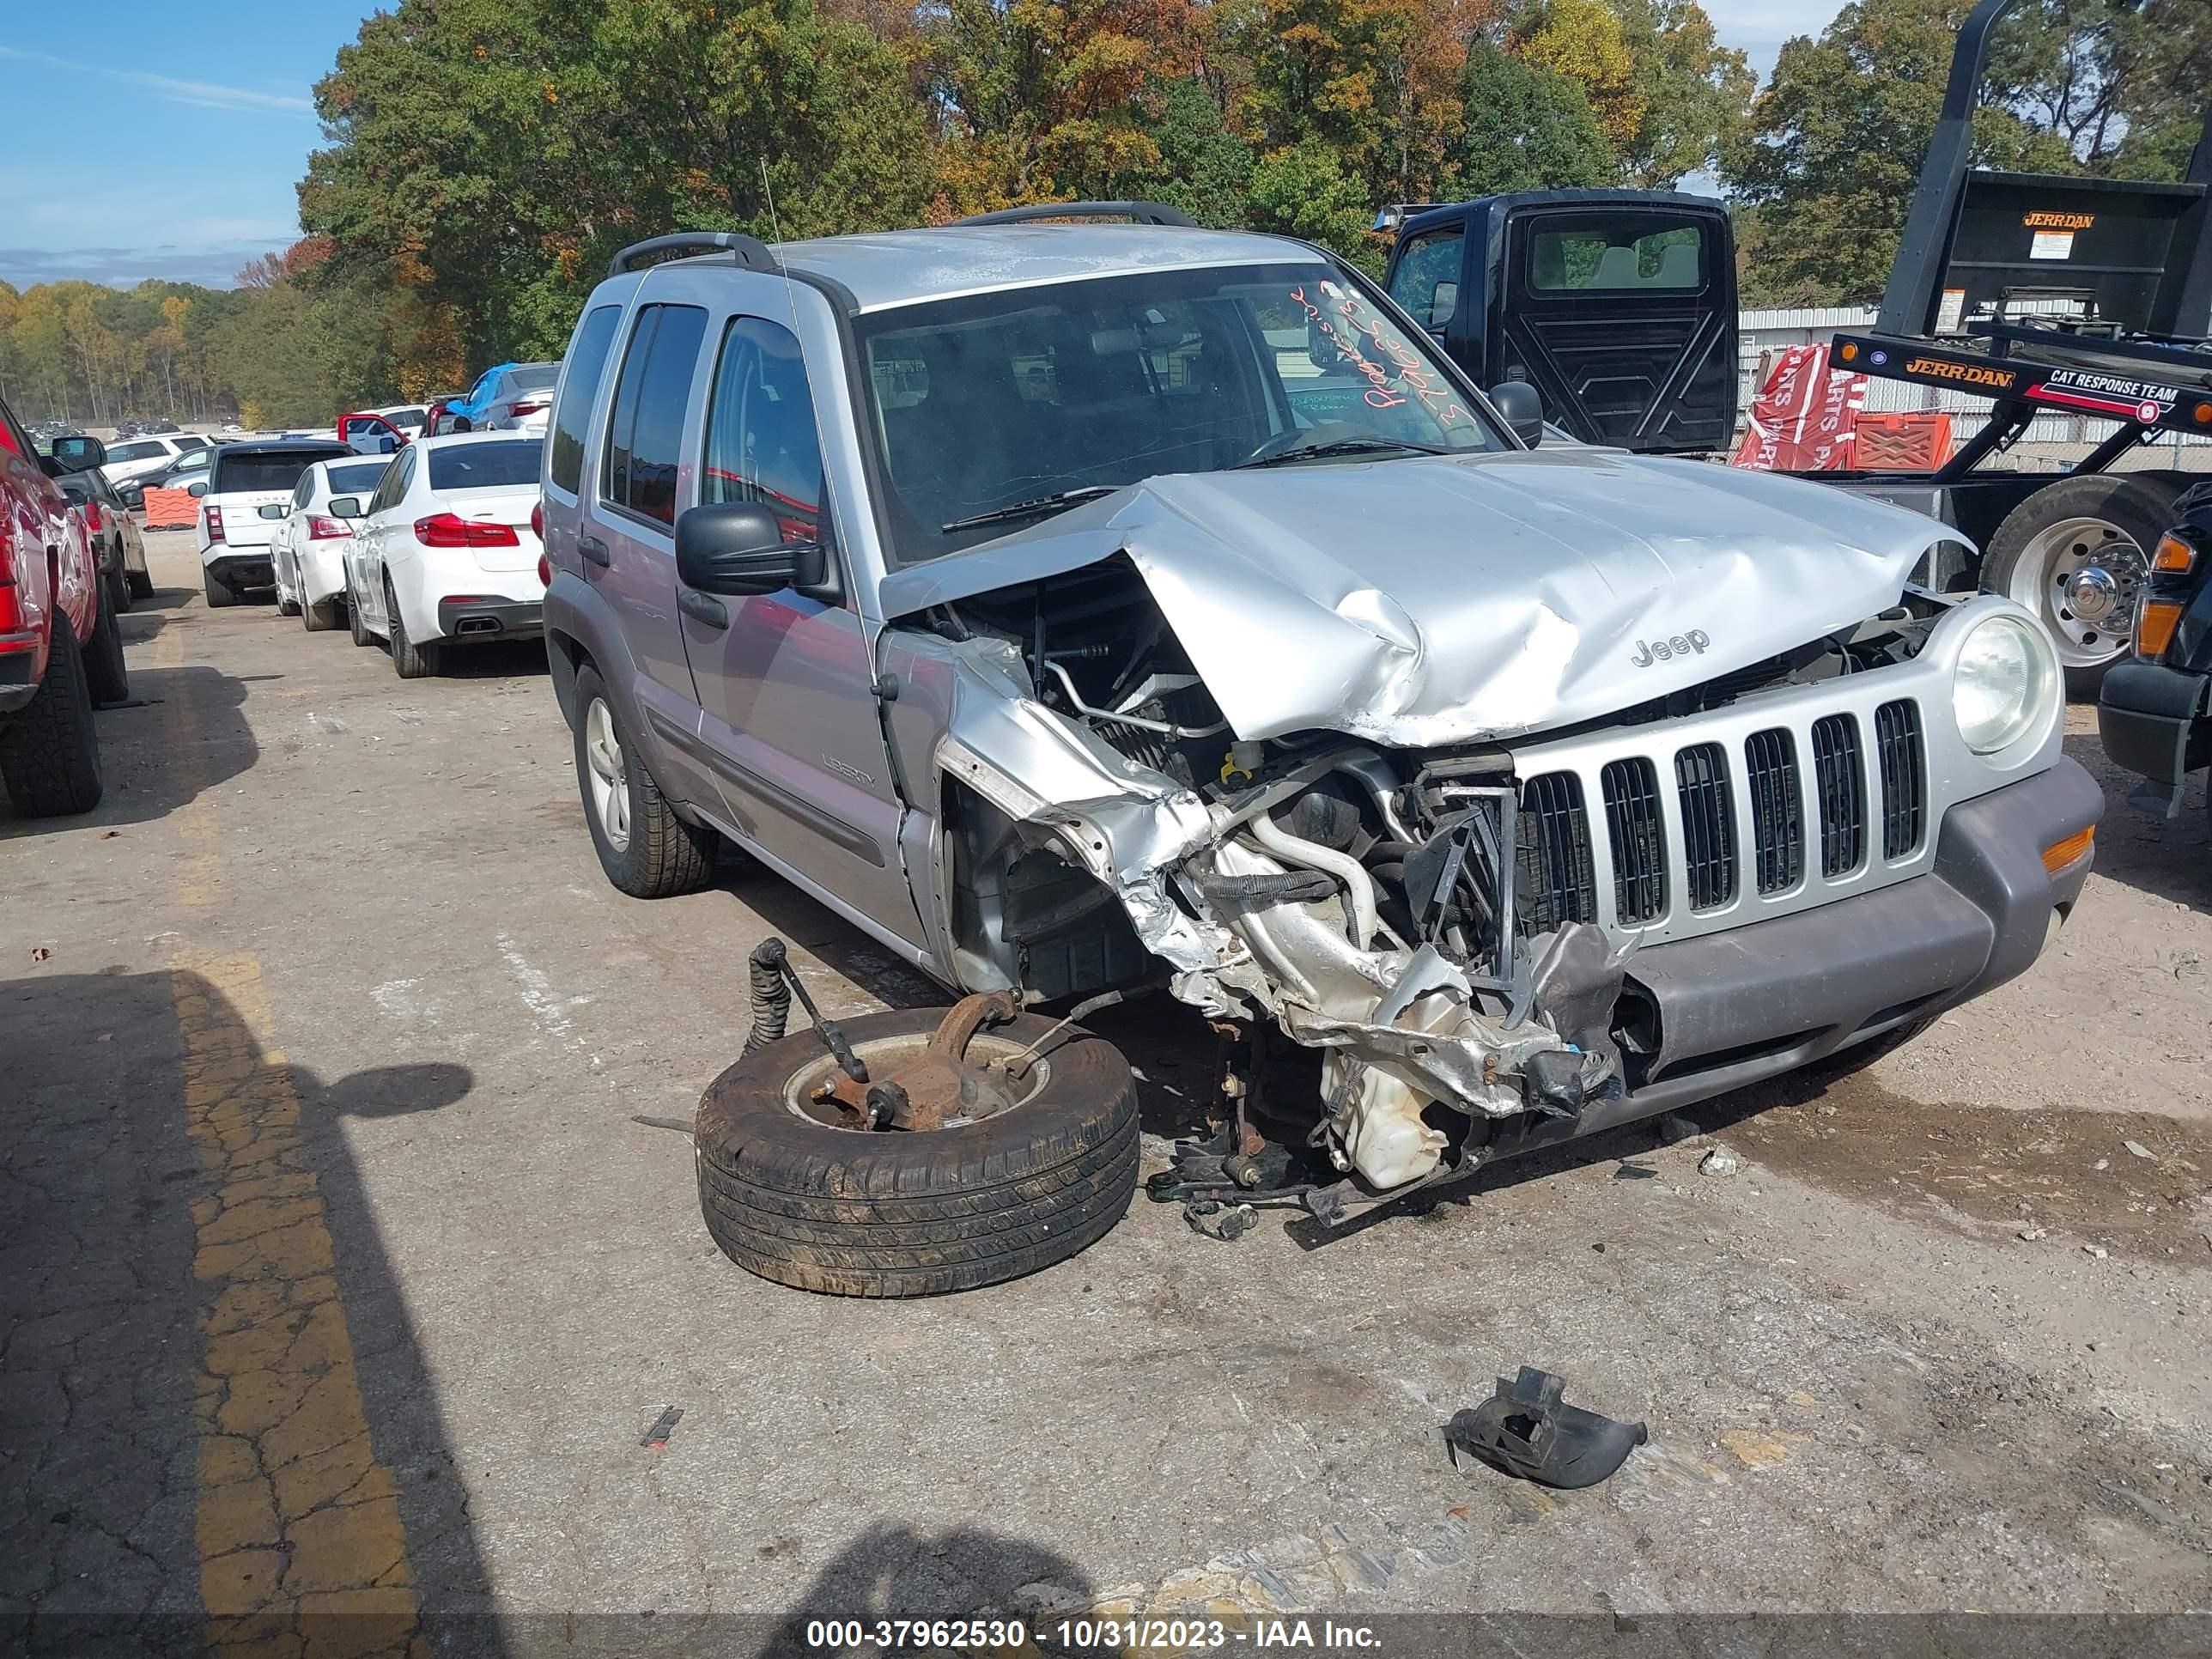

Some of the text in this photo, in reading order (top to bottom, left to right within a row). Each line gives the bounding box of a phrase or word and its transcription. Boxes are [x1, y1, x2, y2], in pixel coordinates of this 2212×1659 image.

[2023, 211, 2095, 229] JERR-DAN
[1905, 358, 2016, 390] JERR-DAN
[2050, 369, 2179, 402] CAT RESPONSE TEAM
[1630, 629, 1711, 668] Jeep
